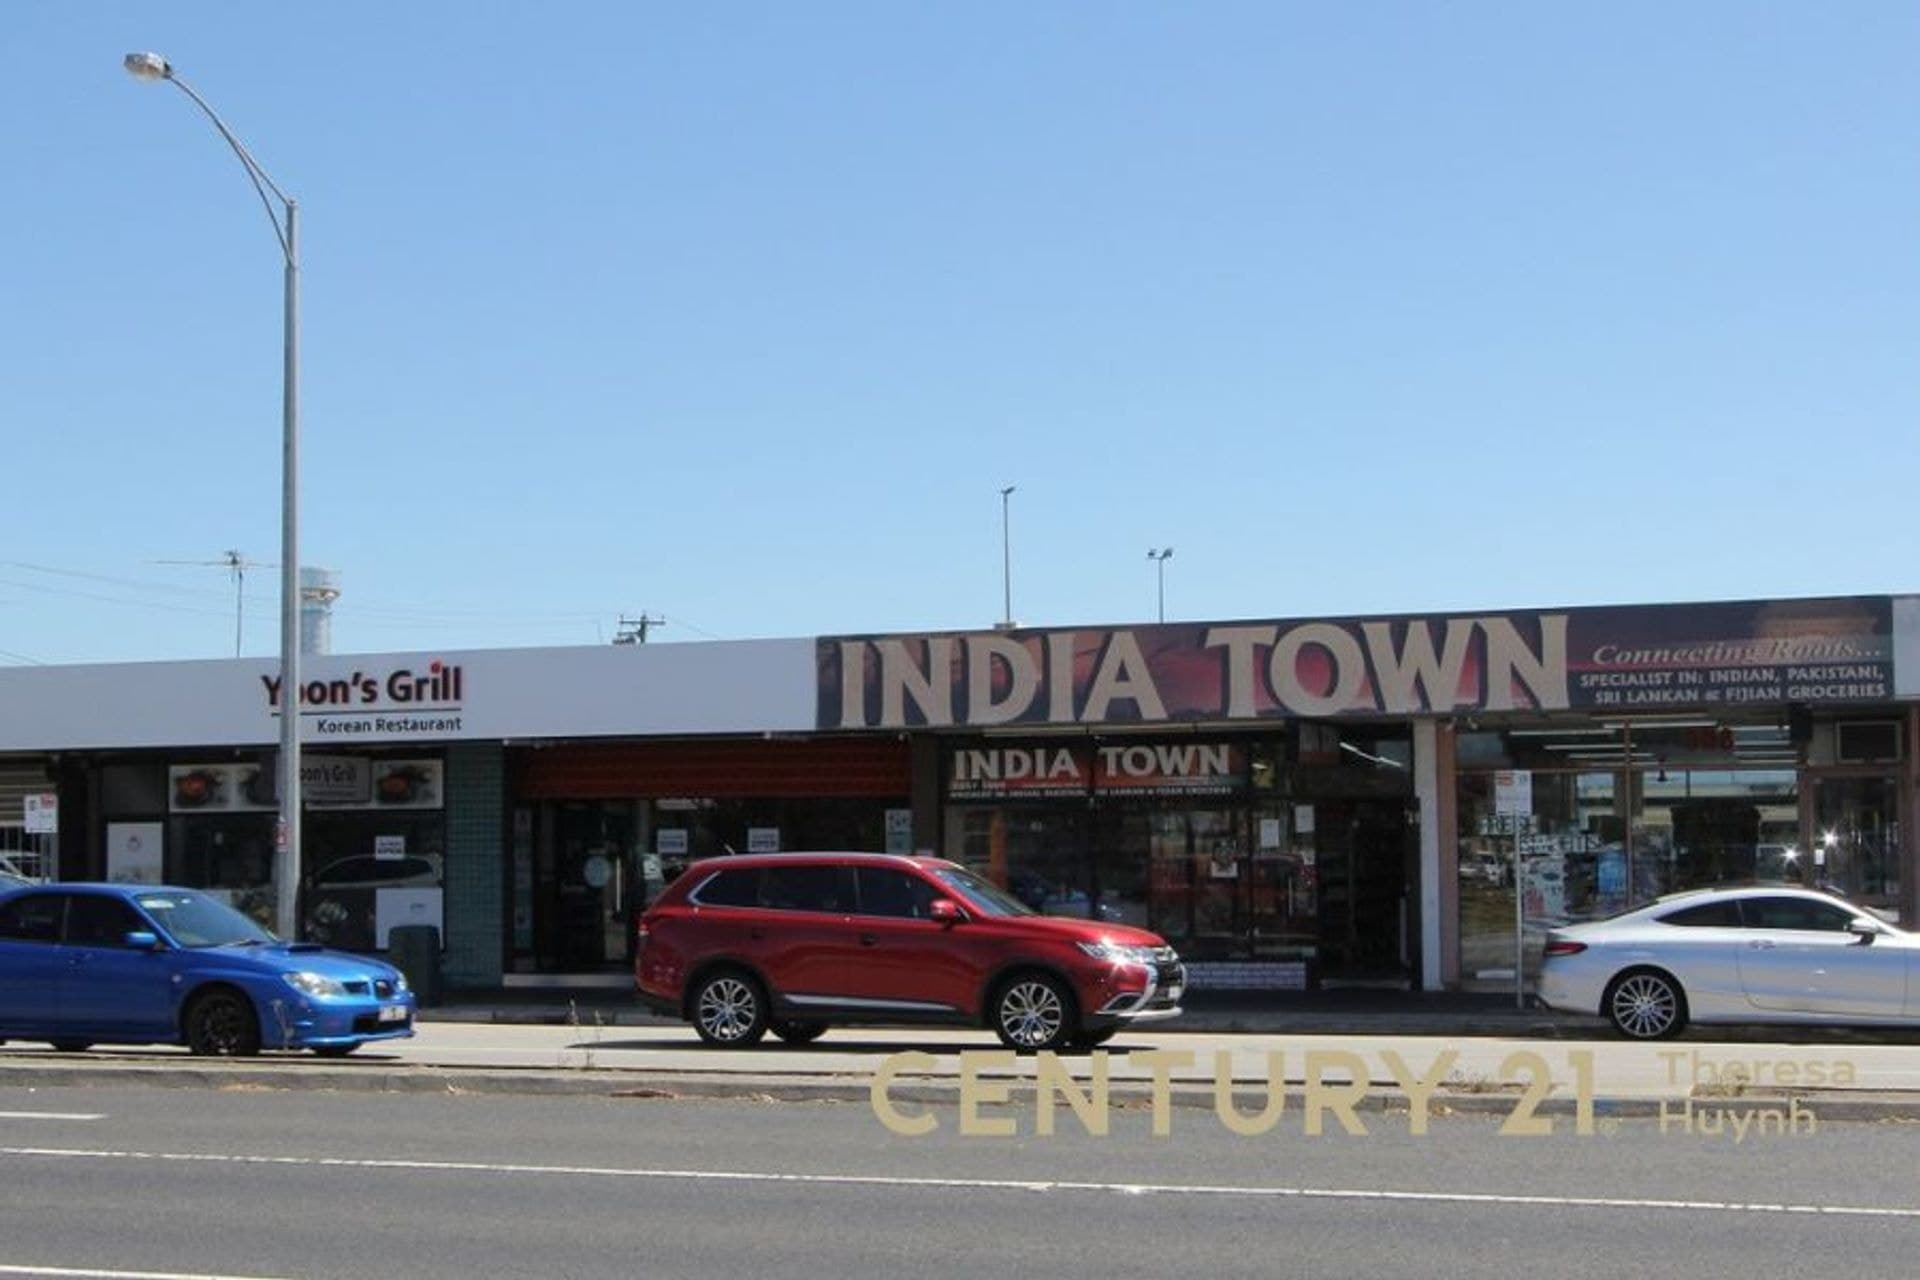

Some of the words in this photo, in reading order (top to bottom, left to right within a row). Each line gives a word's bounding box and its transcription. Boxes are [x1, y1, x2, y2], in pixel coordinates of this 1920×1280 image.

[261, 672, 378, 706] Yon's
[387, 660, 462, 701] Grill
[841, 631, 1168, 728] INDIA
[1204, 614, 1570, 718] TOWN
[1580, 671, 1674, 687] SPECIALIST
[1595, 690, 1621, 704] SRI
[1627, 688, 1699, 703] LANKAN
[1726, 686, 1781, 701] FIJIAN
[1788, 683, 1886, 699] GROCERIES
[317, 718, 371, 734] Korean
[375, 716, 462, 733] Restaurant
[954, 748, 1080, 780] INDIA
[1100, 744, 1229, 777] TOWN
